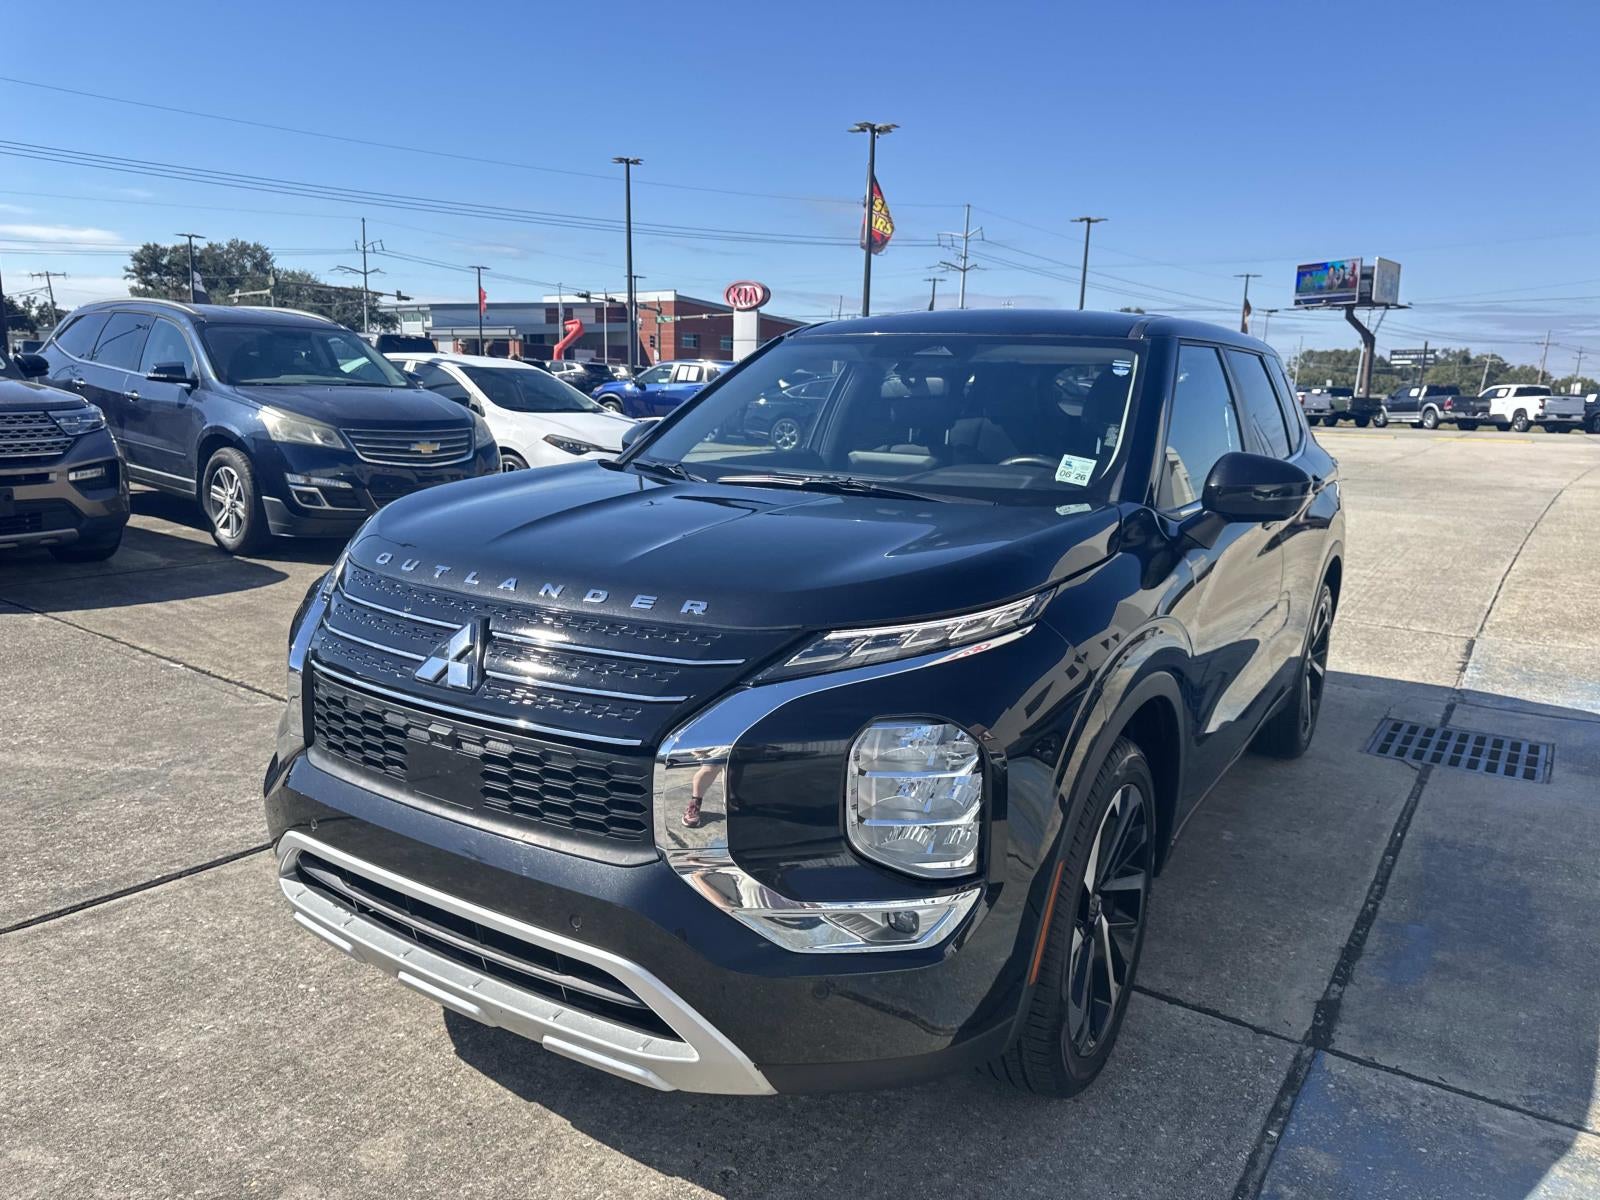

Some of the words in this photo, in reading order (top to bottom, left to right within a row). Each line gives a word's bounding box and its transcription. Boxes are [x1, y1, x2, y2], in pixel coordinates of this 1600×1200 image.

[872, 214, 893, 235] RS
[730, 287, 758, 304] KIA
[1059, 469, 1072, 478] 06
[1074, 473, 1087, 481] 26
[375, 551, 710, 616] OUTLANDER
